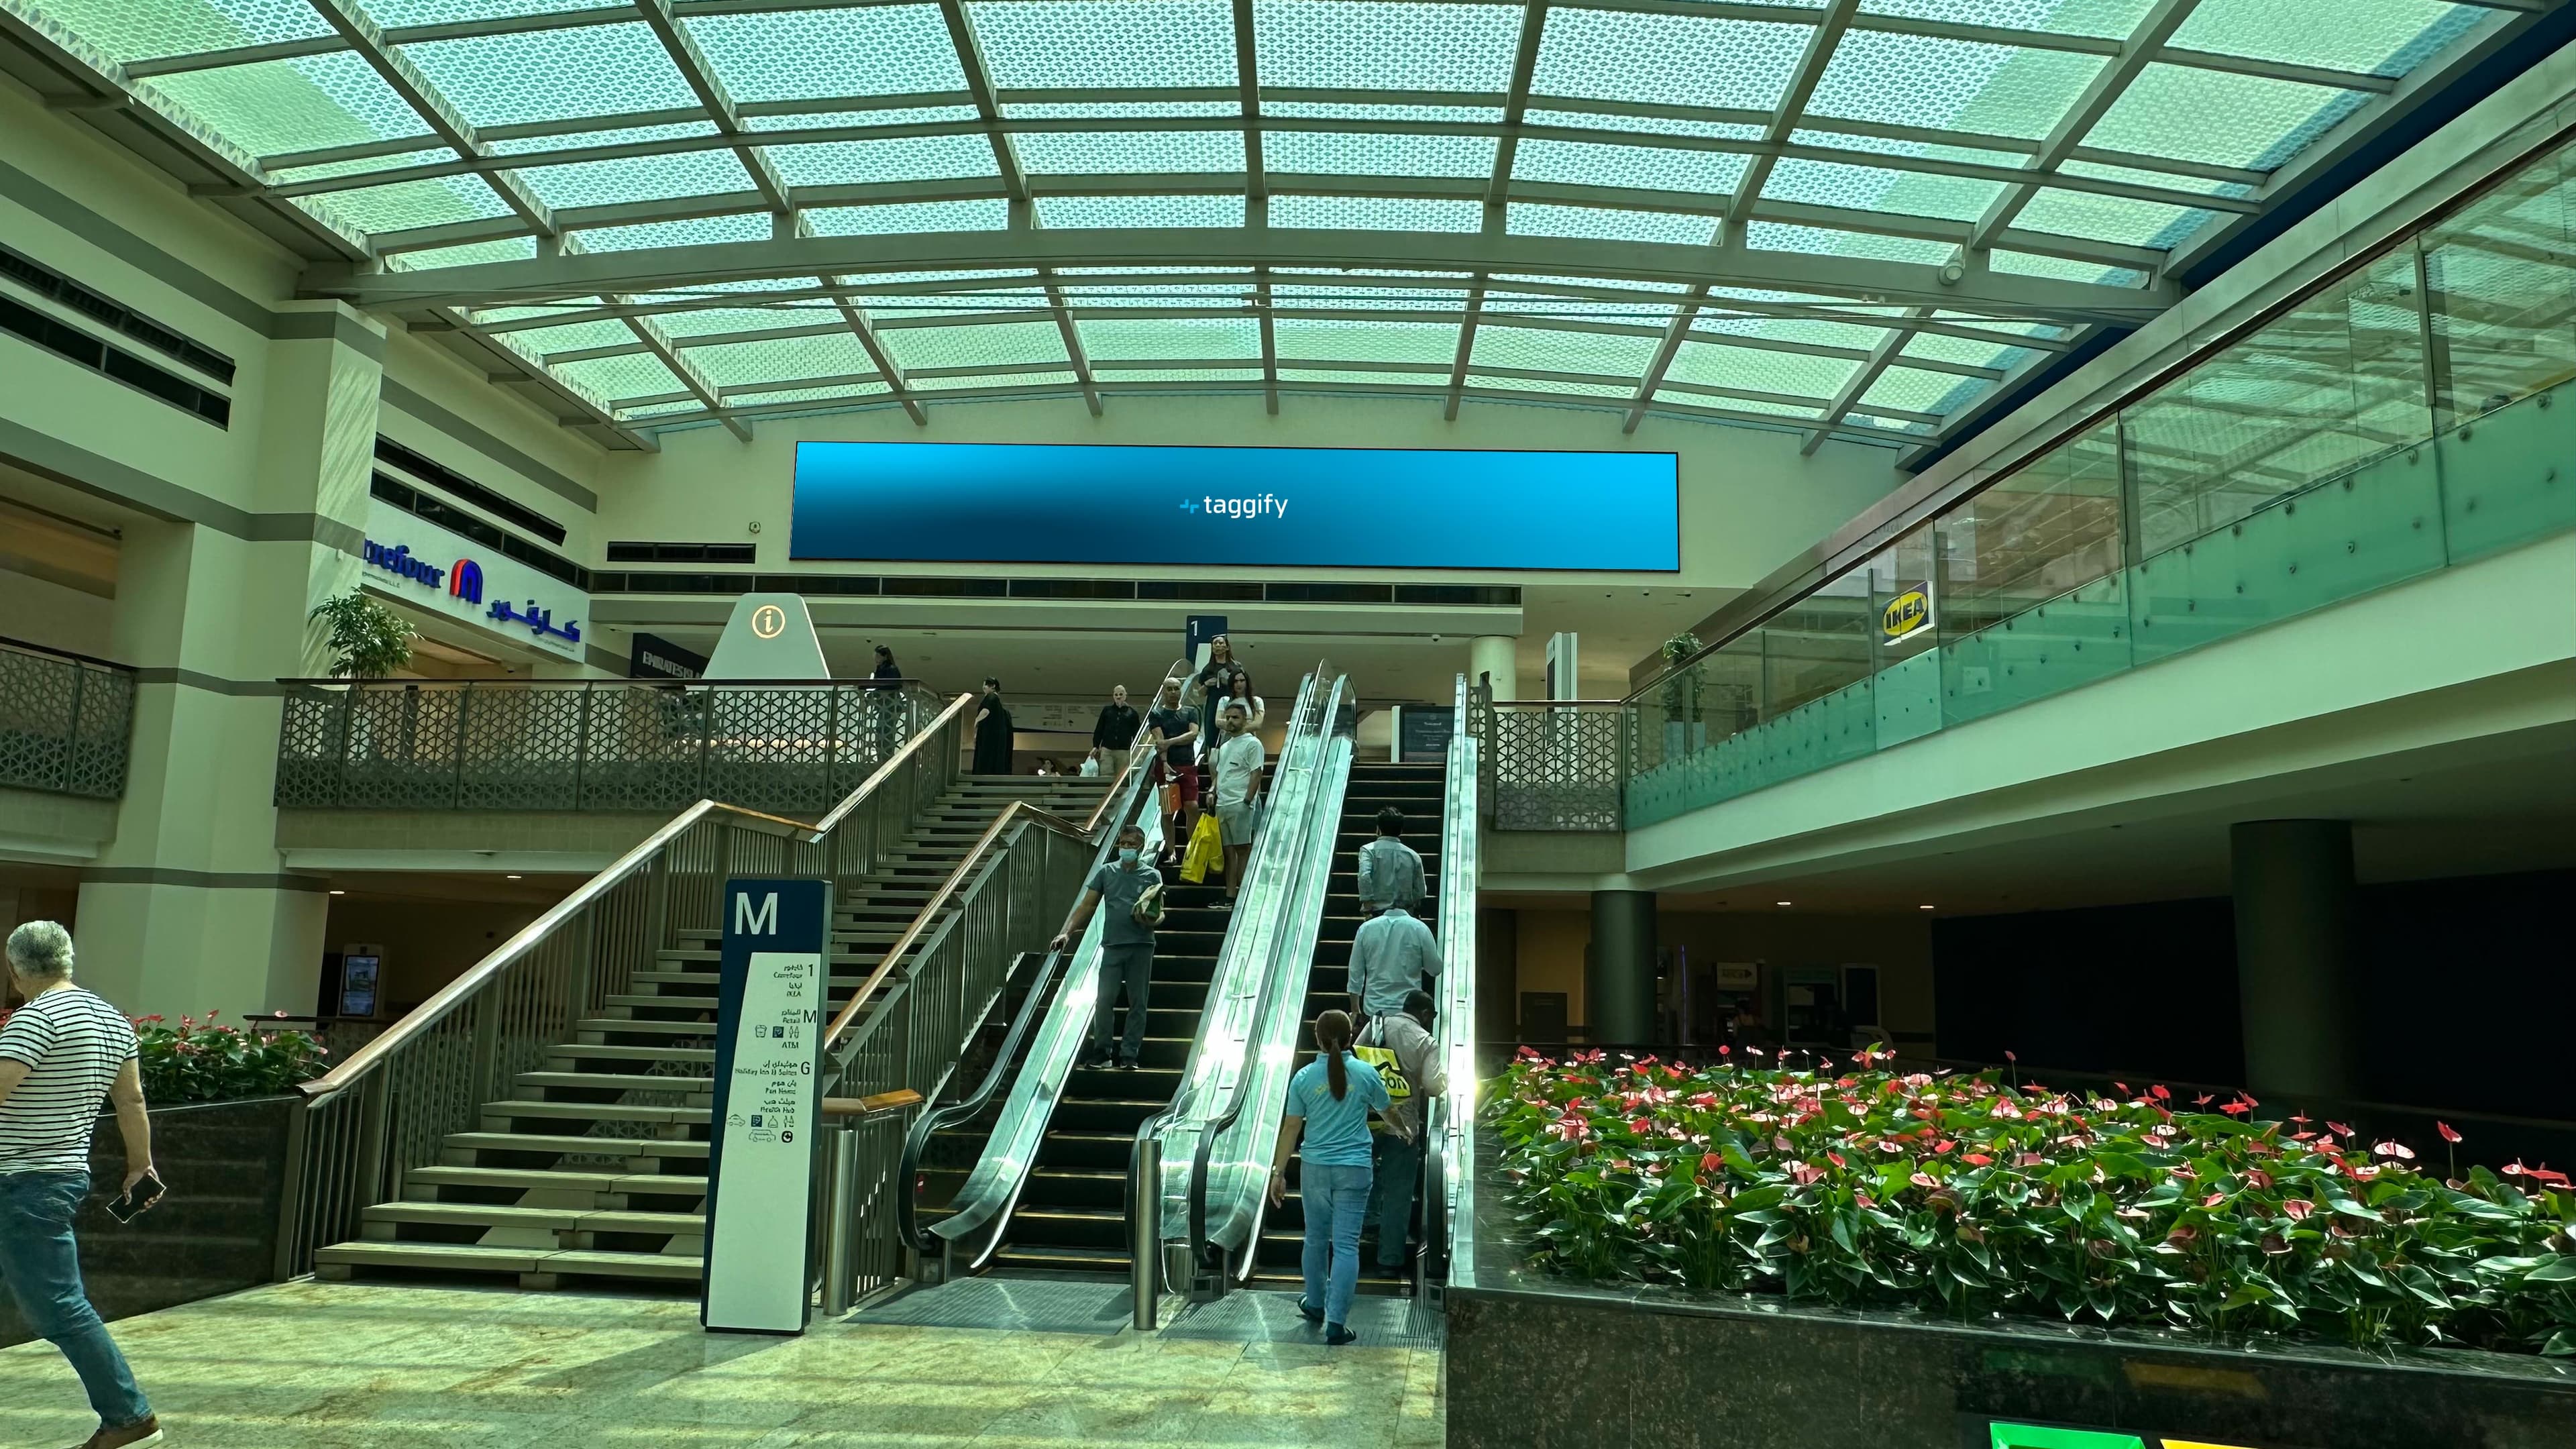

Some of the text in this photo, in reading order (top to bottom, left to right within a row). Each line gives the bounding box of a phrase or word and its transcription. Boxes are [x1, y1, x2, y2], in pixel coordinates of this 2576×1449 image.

[1203, 494, 1288, 519] taggify
[1886, 597, 1924, 629] IKEA
[1191, 621, 1197, 637] 1
[735, 892, 778, 934] M
[808, 964, 813, 977] 1
[803, 1010, 816, 1023] M
[801, 1061, 810, 1075] G
